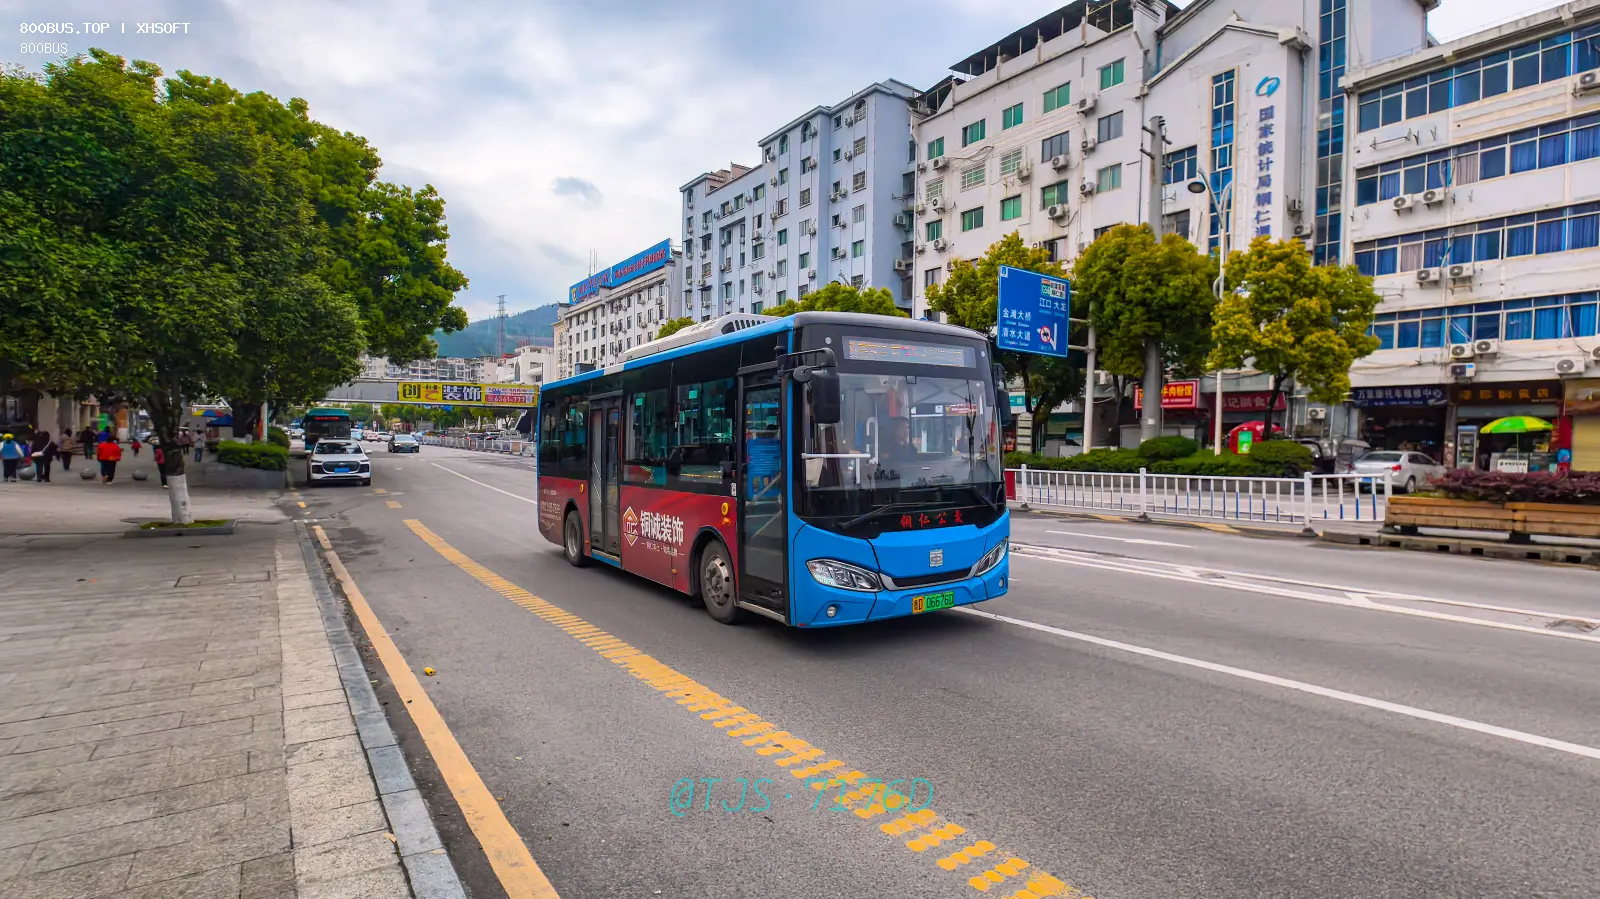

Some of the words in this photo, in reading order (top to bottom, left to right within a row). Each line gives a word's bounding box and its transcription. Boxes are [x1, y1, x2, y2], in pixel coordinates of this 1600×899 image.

[1001, 327, 1031, 342] 清水大道
[640, 509, 684, 547] 铜诚装饰
